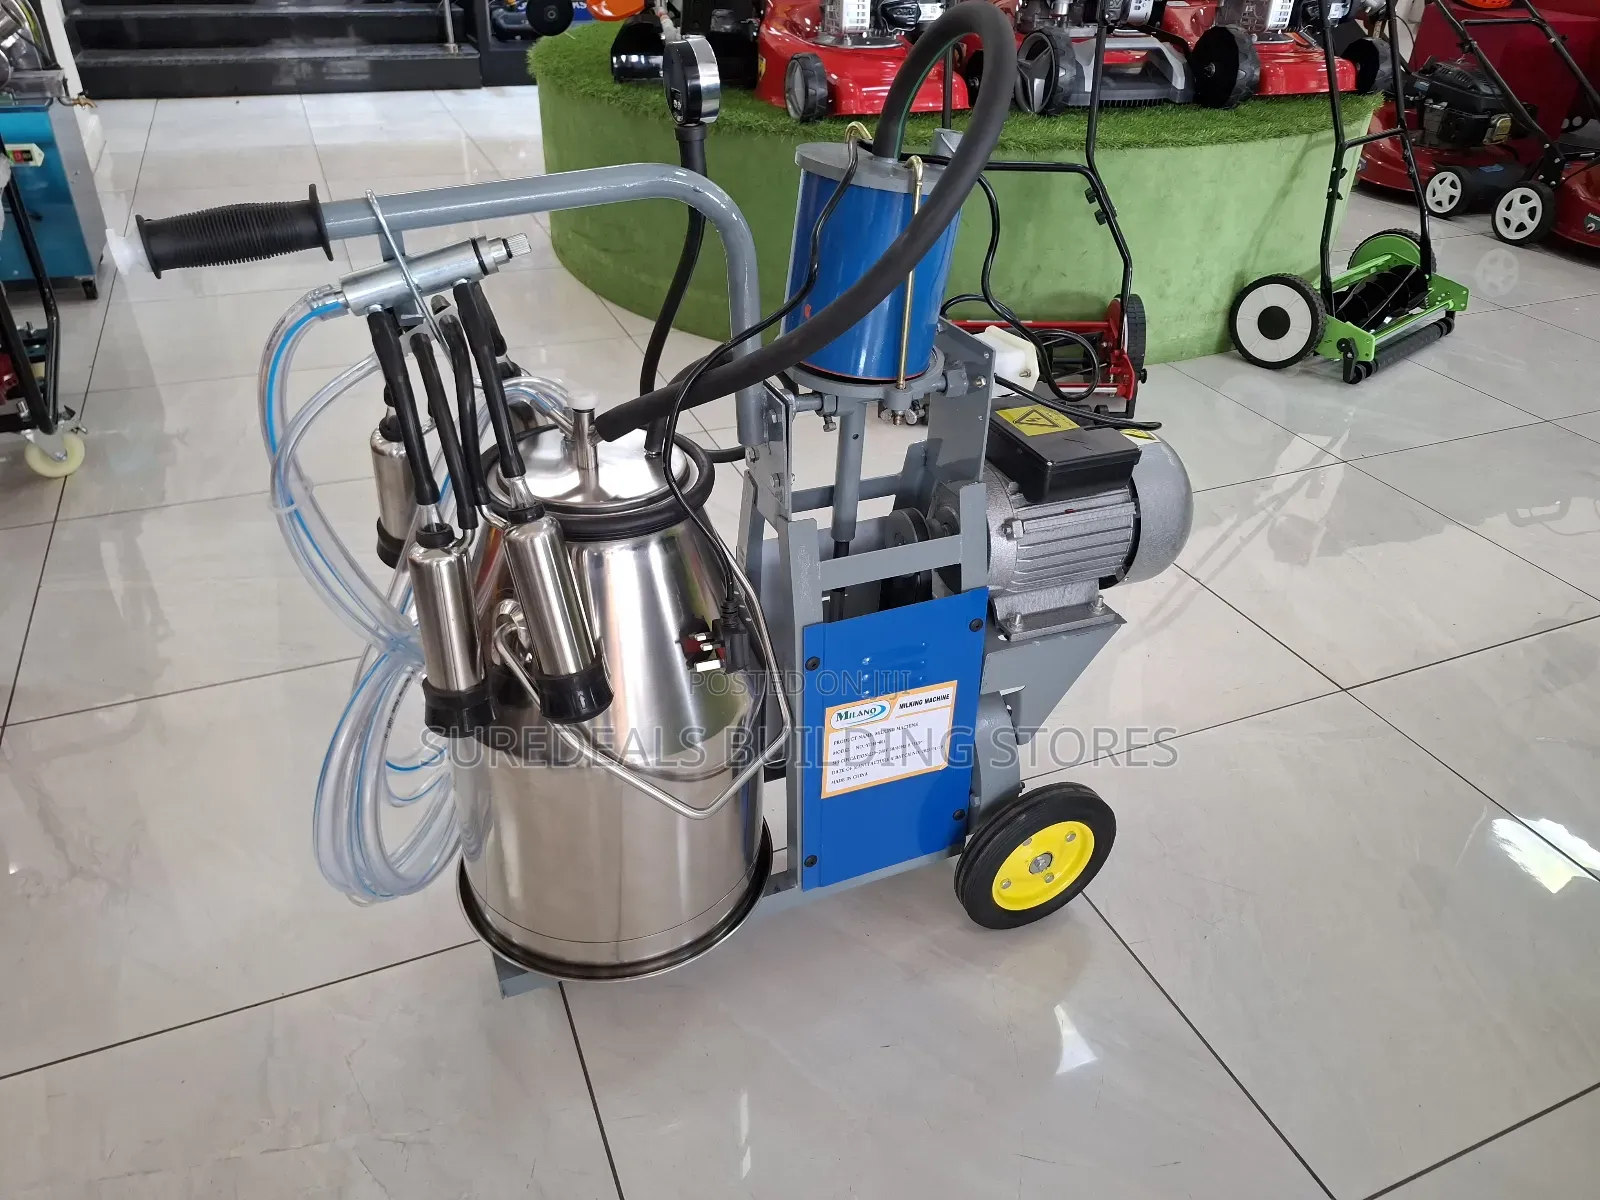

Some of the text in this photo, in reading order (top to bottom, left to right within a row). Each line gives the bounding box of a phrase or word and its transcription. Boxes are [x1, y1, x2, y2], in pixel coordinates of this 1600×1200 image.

[899, 692, 950, 709] MILKING MACHINE
[835, 706, 876, 722] MILANO
